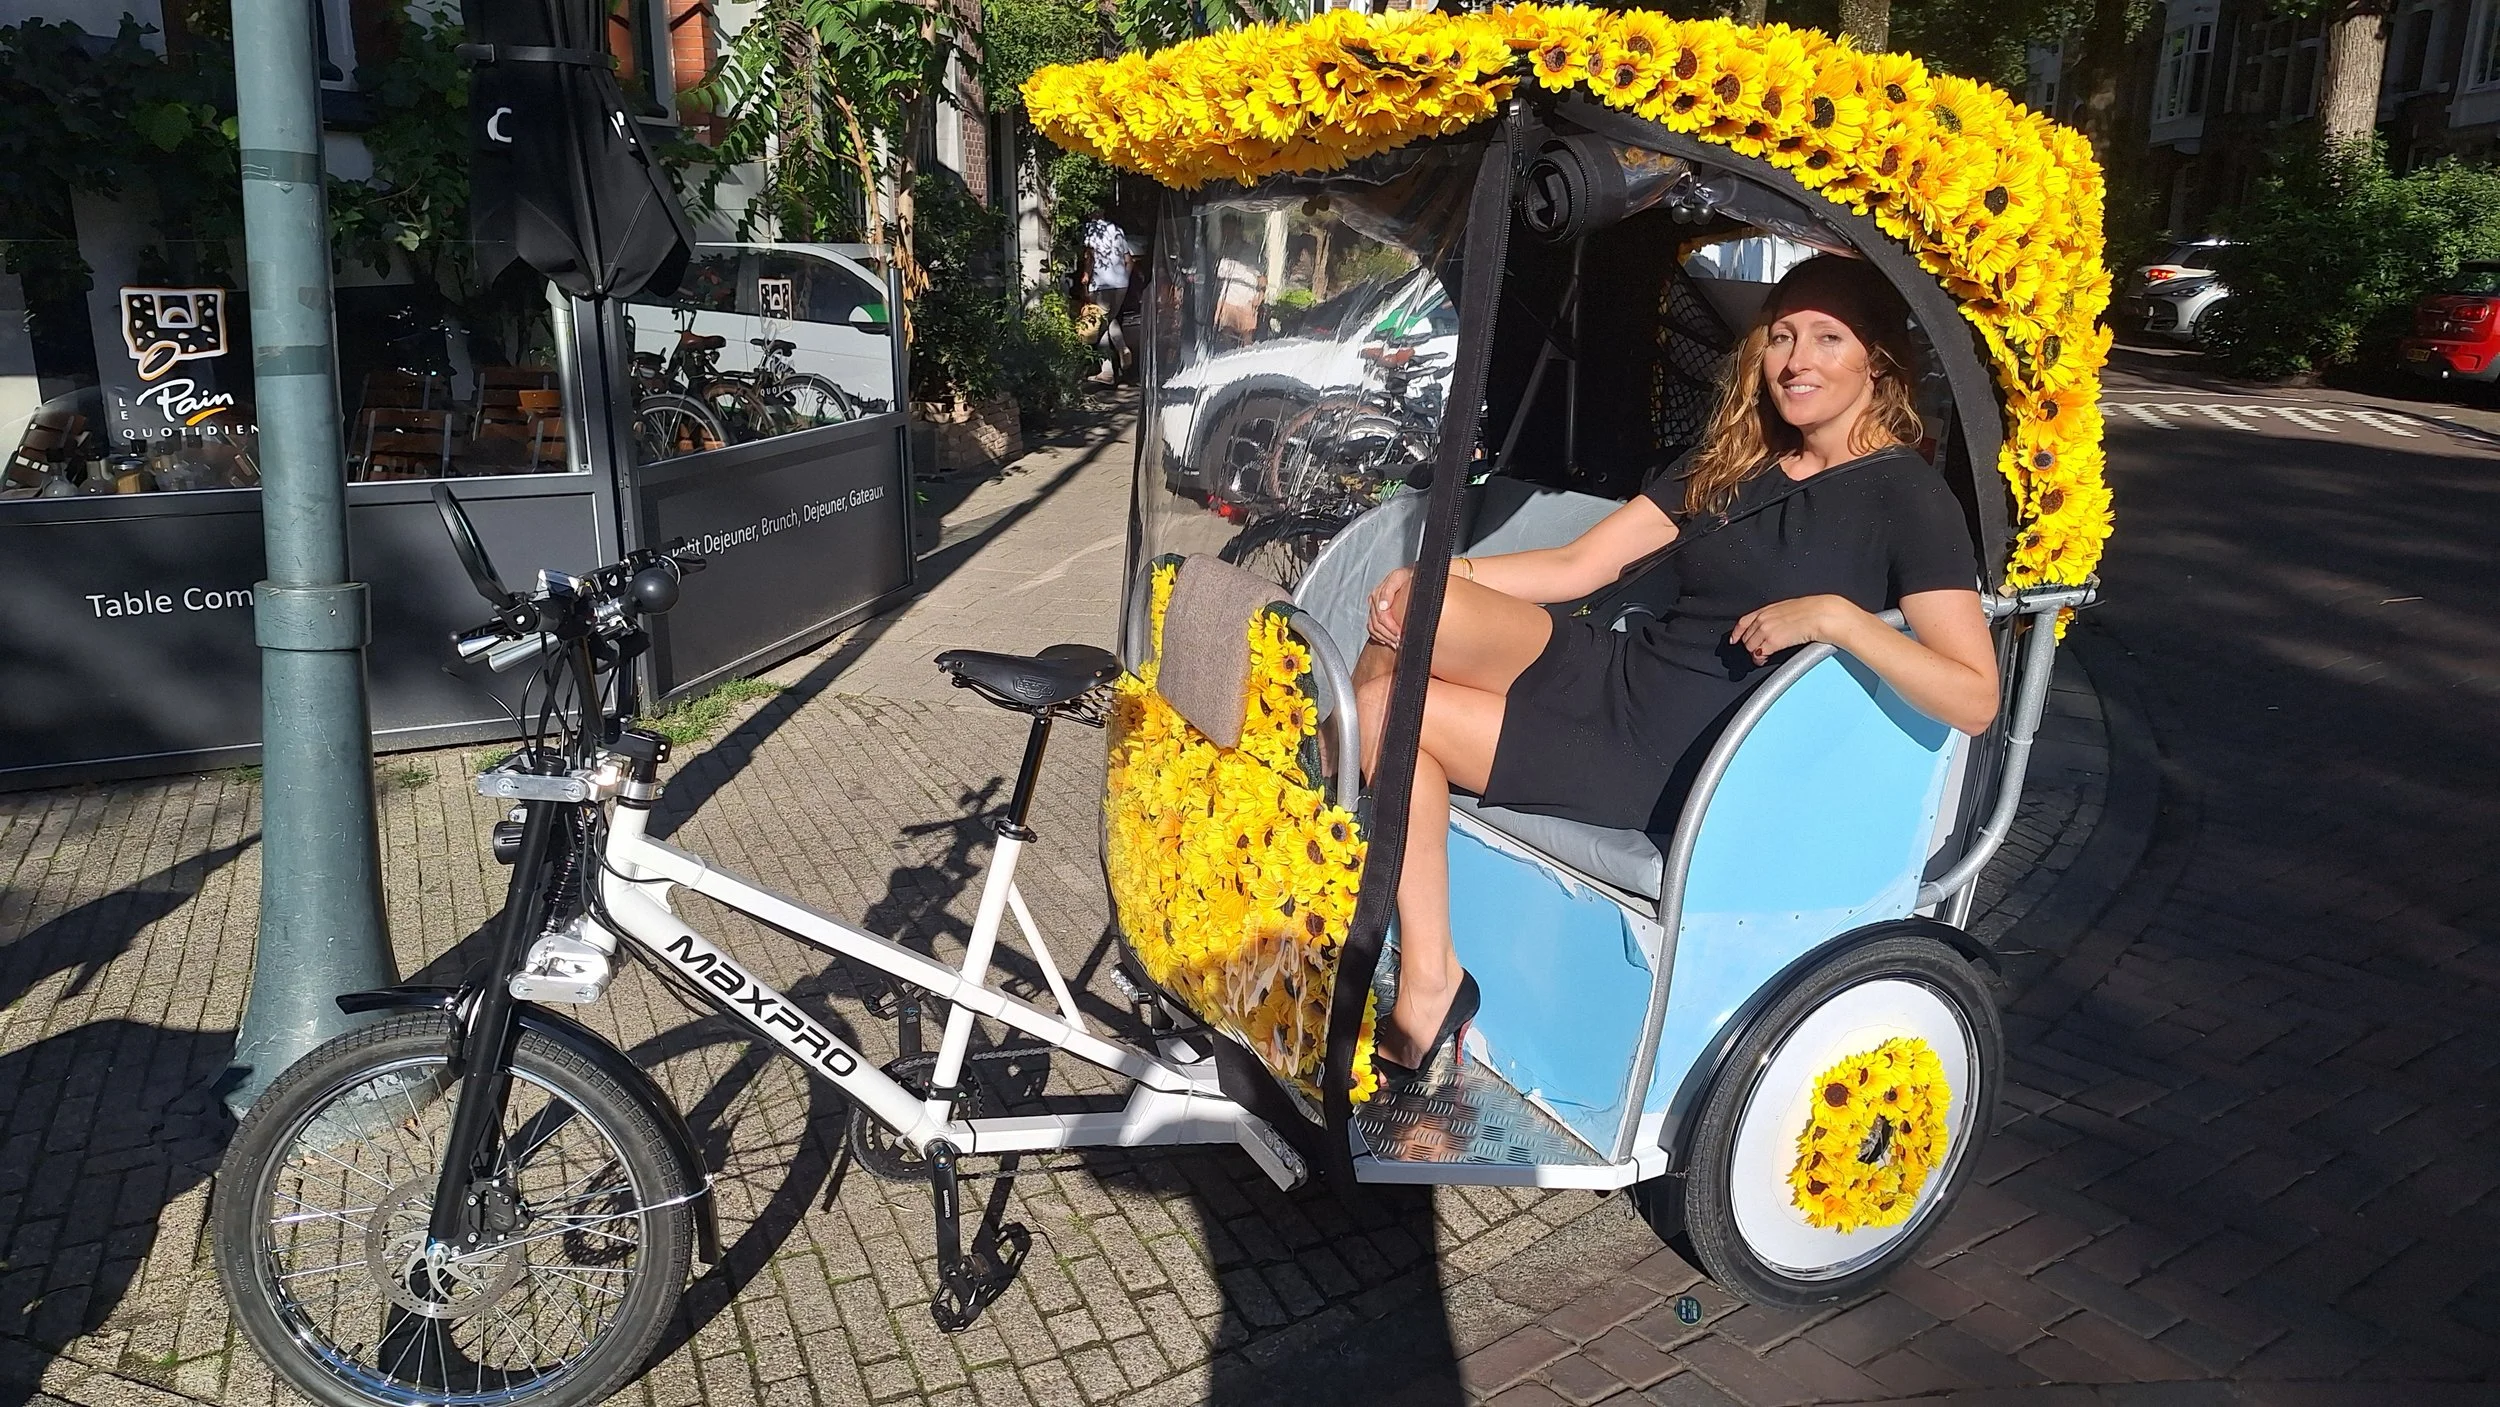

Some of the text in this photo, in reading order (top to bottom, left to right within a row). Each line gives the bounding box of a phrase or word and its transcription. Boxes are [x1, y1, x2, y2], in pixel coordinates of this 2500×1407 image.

[136, 378, 234, 422] Pain
[122, 424, 259, 440] QUOTIDIEN
[704, 524, 759, 555] Dejeuner,
[761, 508, 802, 537] Brunch,
[803, 496, 849, 523] Dejeuner,
[849, 485, 885, 507] Gateaux
[85, 590, 173, 618] Table
